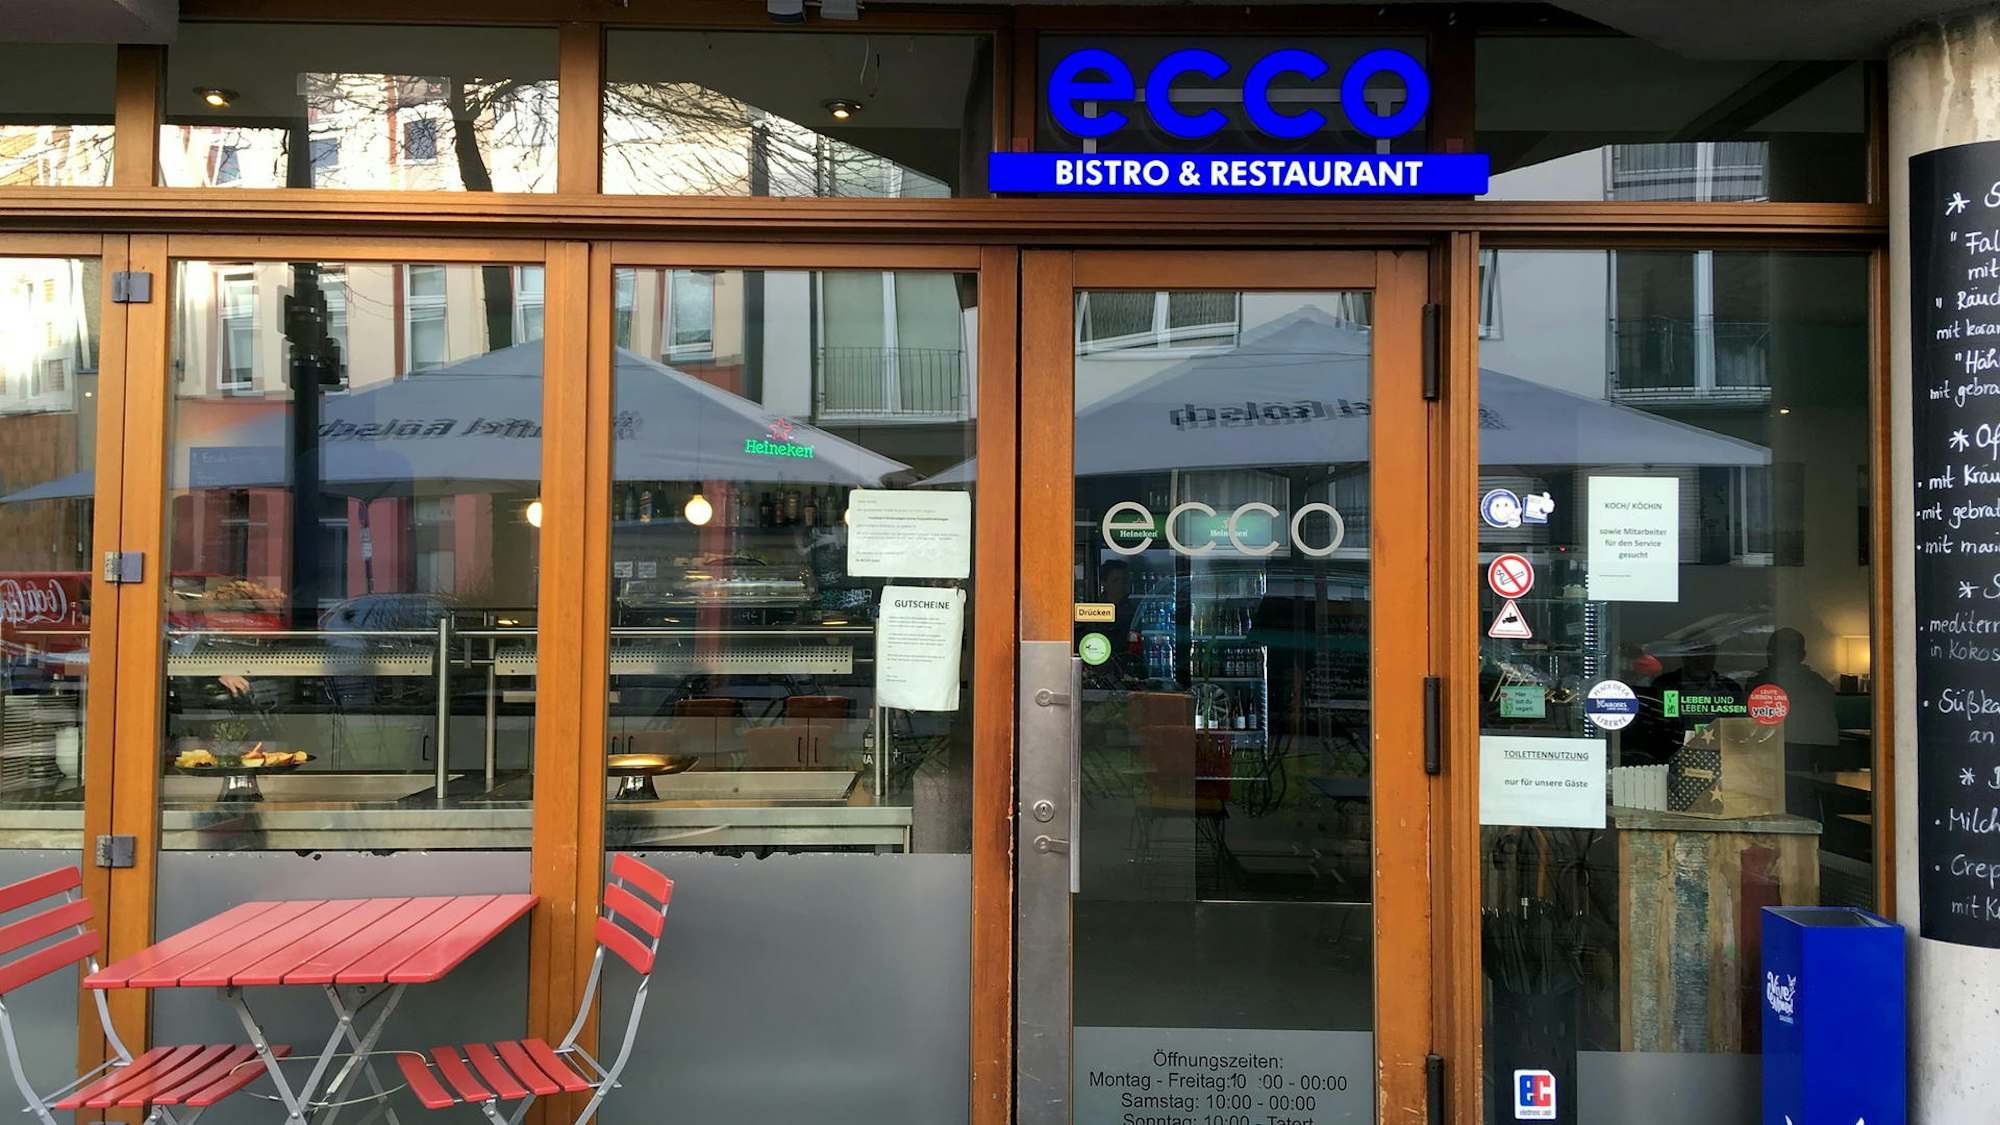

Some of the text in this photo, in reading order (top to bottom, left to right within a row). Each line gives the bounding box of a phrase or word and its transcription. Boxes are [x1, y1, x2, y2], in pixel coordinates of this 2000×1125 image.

[1048, 48, 1431, 139] ecco
[1055, 159, 1424, 188] BISTRO & RESTAURANT
[1968, 258, 2000, 281] mit
[1936, 320, 1962, 340] mit
[1930, 379, 1951, 400] mit
[744, 439, 815, 458] Heineken
[1929, 464, 1956, 490] mit
[1922, 501, 1943, 521] mit
[1102, 501, 1344, 556] ecco
[1120, 530, 1158, 538] Heineken
[1599, 528, 1667, 536] sowie Mitarbeiter
[1605, 539, 1662, 548] für den Service
[1925, 534, 1954, 554] mit
[1619, 551, 1649, 560] gesucht
[895, 600, 950, 610] GUTSCHEINE
[1079, 608, 1111, 616] Drücken
[1681, 696, 1734, 704] LEBEN UND
[1681, 705, 1747, 713] LEBEN LASSEN
[1753, 707, 1775, 717] yelp
[1503, 750, 1590, 760] TOILETTENNUTZUNG
[1520, 778, 1532, 786] für
[1534, 779, 1563, 787] unsere
[1564, 779, 1589, 788] Gäste
[1952, 894, 1980, 918] mit
[1153, 1049, 1284, 1071] Öffnungszeiten:
[1089, 1072, 1151, 1091] Montag
[1300, 1075, 1348, 1091] 00:00
[1121, 1092, 1199, 1112] Samstag:
[1206, 1094, 1252, 1110] 10:00
[1269, 1095, 1317, 1111] 00:00
